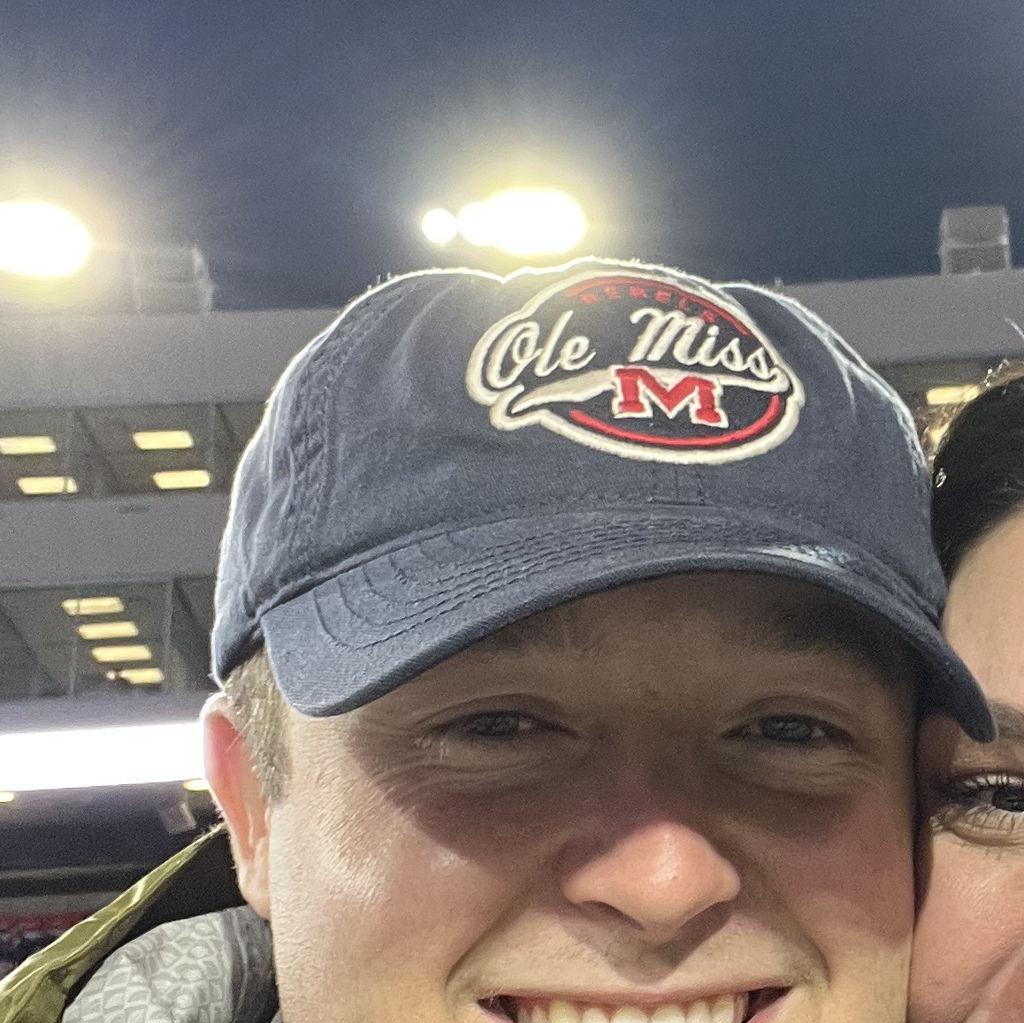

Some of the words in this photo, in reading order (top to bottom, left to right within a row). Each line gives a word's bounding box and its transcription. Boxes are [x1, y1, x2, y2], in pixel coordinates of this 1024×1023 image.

[485, 309, 597, 389] Ole
[628, 306, 780, 386] Miss
[610, 364, 730, 429] M
